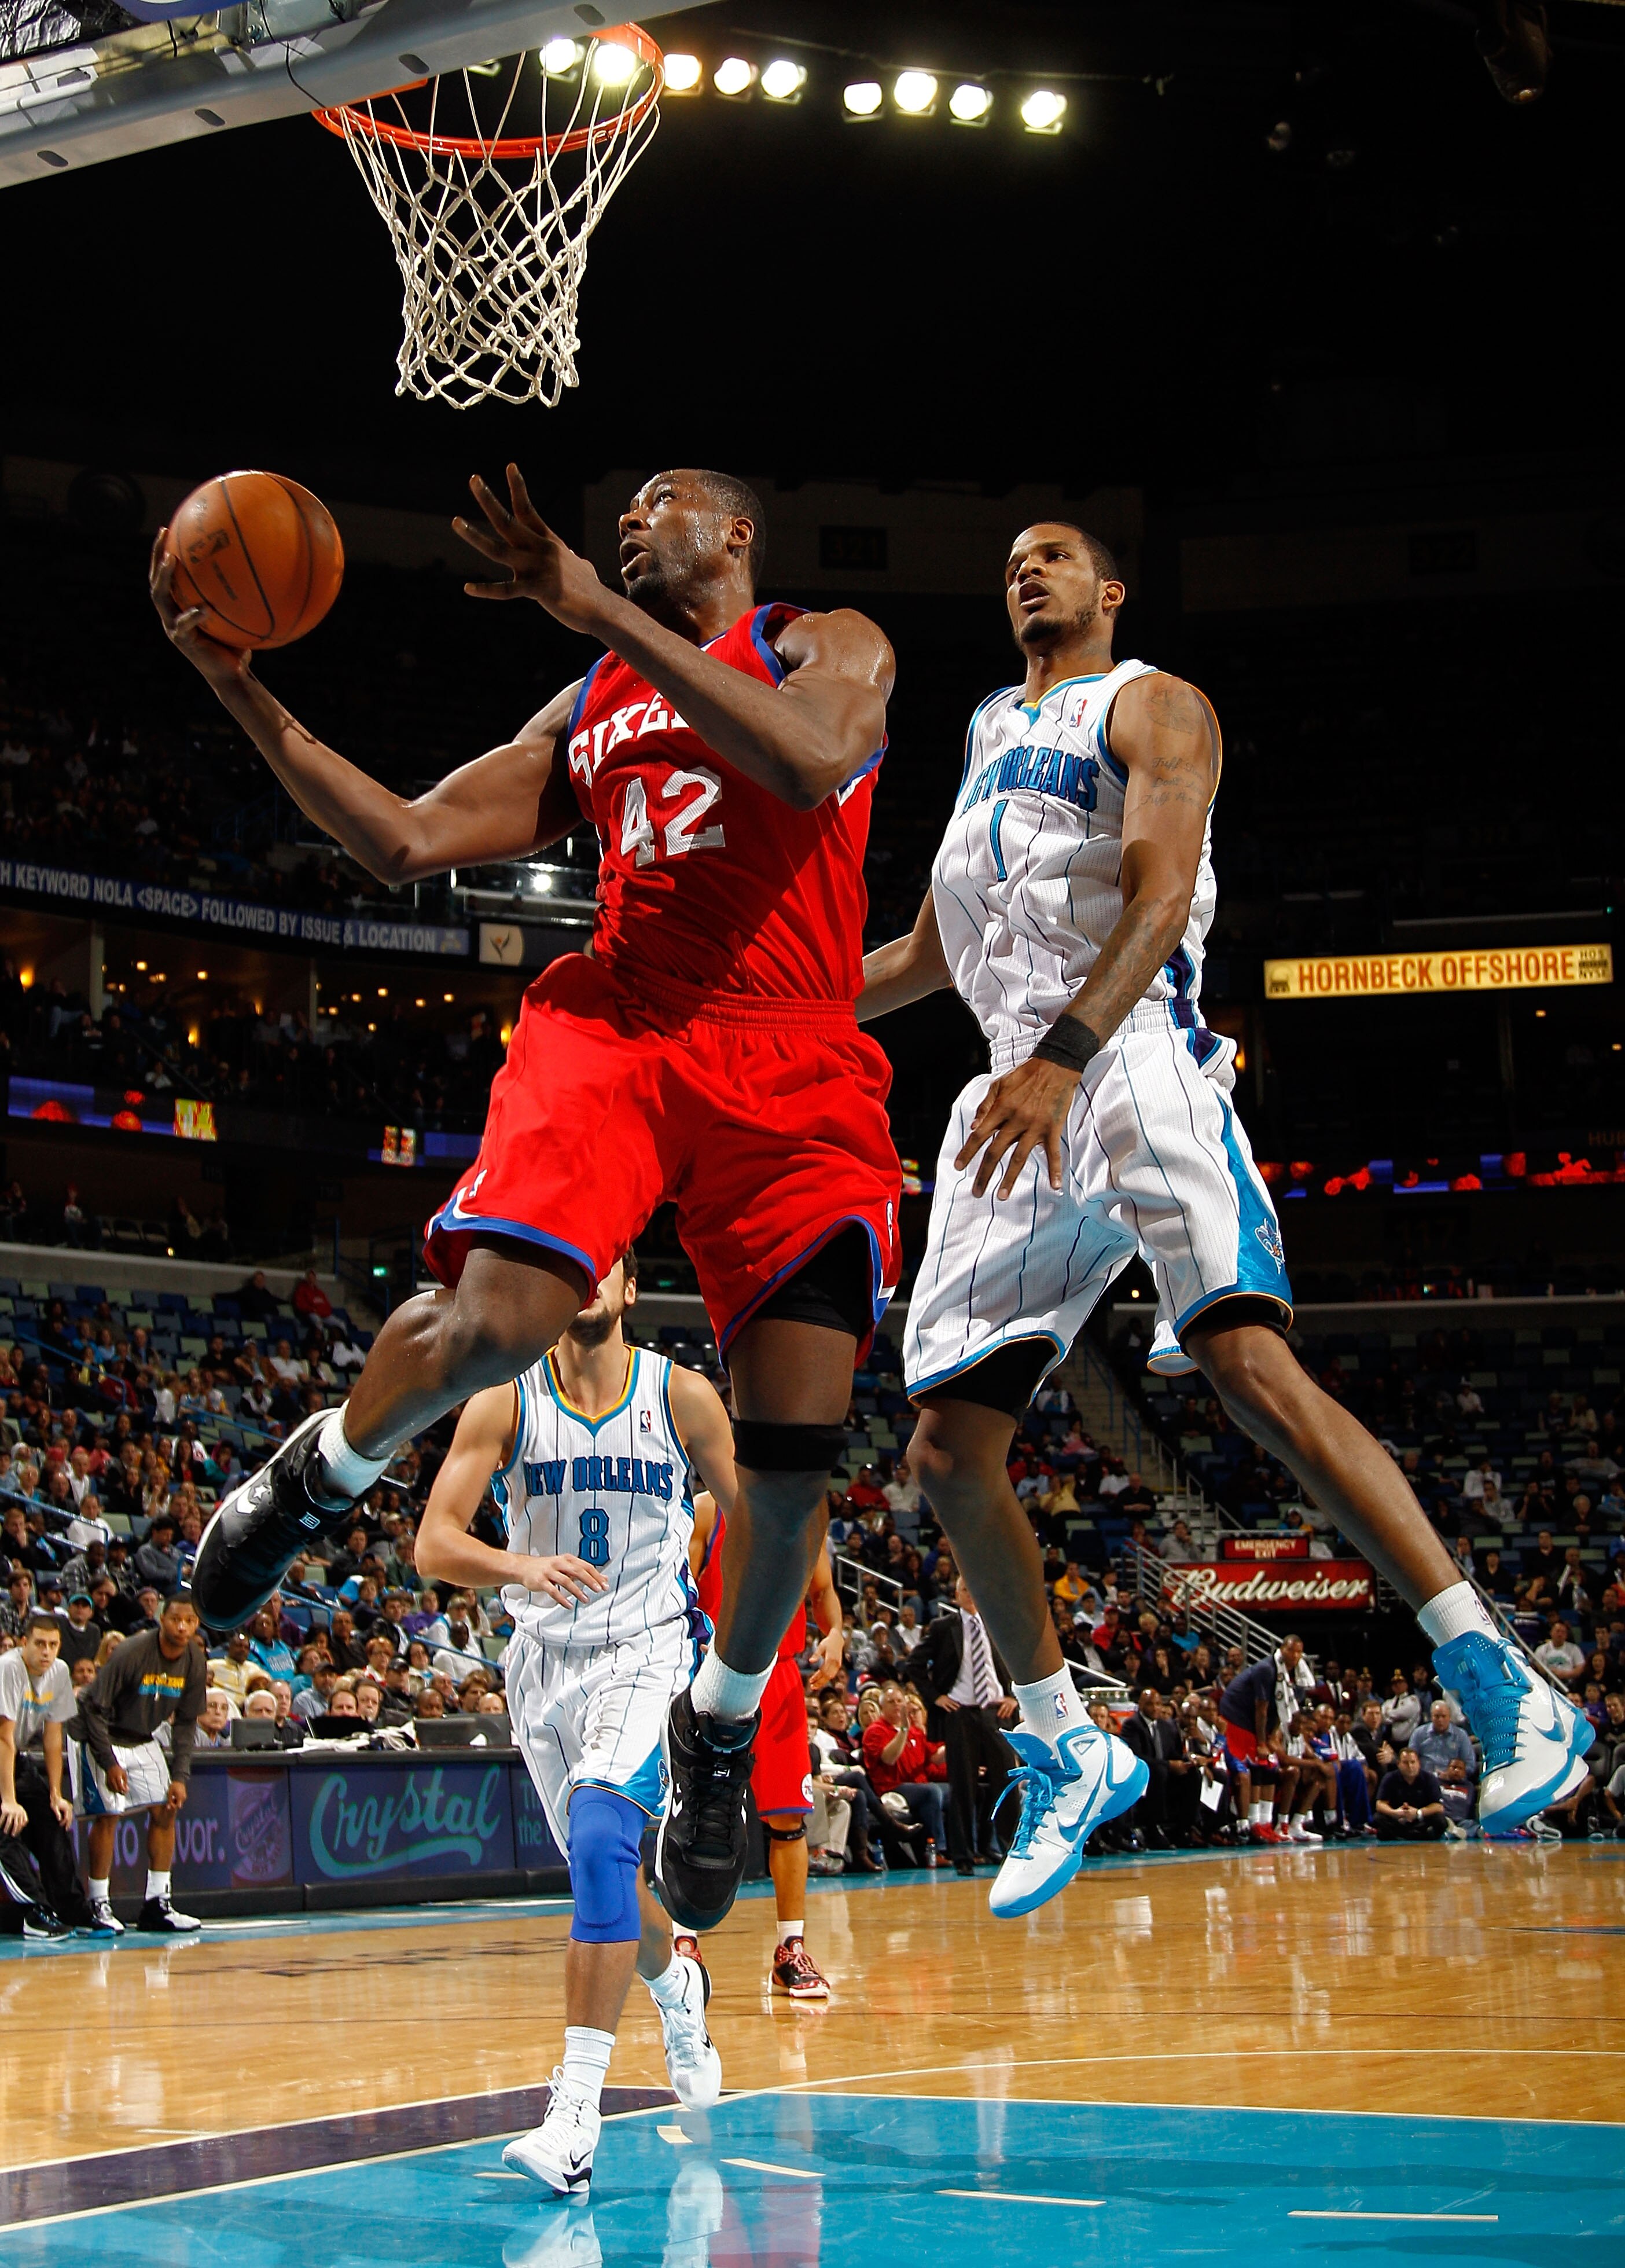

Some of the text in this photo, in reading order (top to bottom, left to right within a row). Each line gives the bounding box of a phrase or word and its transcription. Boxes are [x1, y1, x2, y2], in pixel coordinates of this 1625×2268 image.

[568, 692, 690, 788] SIXE
[997, 744, 1100, 813] ORLEANS
[621, 765, 726, 868] 42
[990, 799, 1009, 882] 1
[15, 864, 90, 900] KEYWORD
[93, 877, 133, 907] NOLA
[137, 887, 198, 918] <SPACE>
[201, 897, 274, 933] FOLLOWED
[278, 912, 297, 937] BY
[300, 915, 340, 945] ISSUE
[343, 923, 353, 947] &
[358, 924, 435, 952] LOCATION
[1298, 950, 1575, 992] HORNBECK OFFSHORE
[572, 1456, 674, 1501] ORLEANS
[579, 1509, 611, 1566] 8
[1234, 1539, 1296, 1551] EMERGENCY
[1255, 1549, 1277, 1558] EXIT
[1163, 1568, 1370, 1606] Budweiser
[310, 1763, 502, 1878] Crystal
